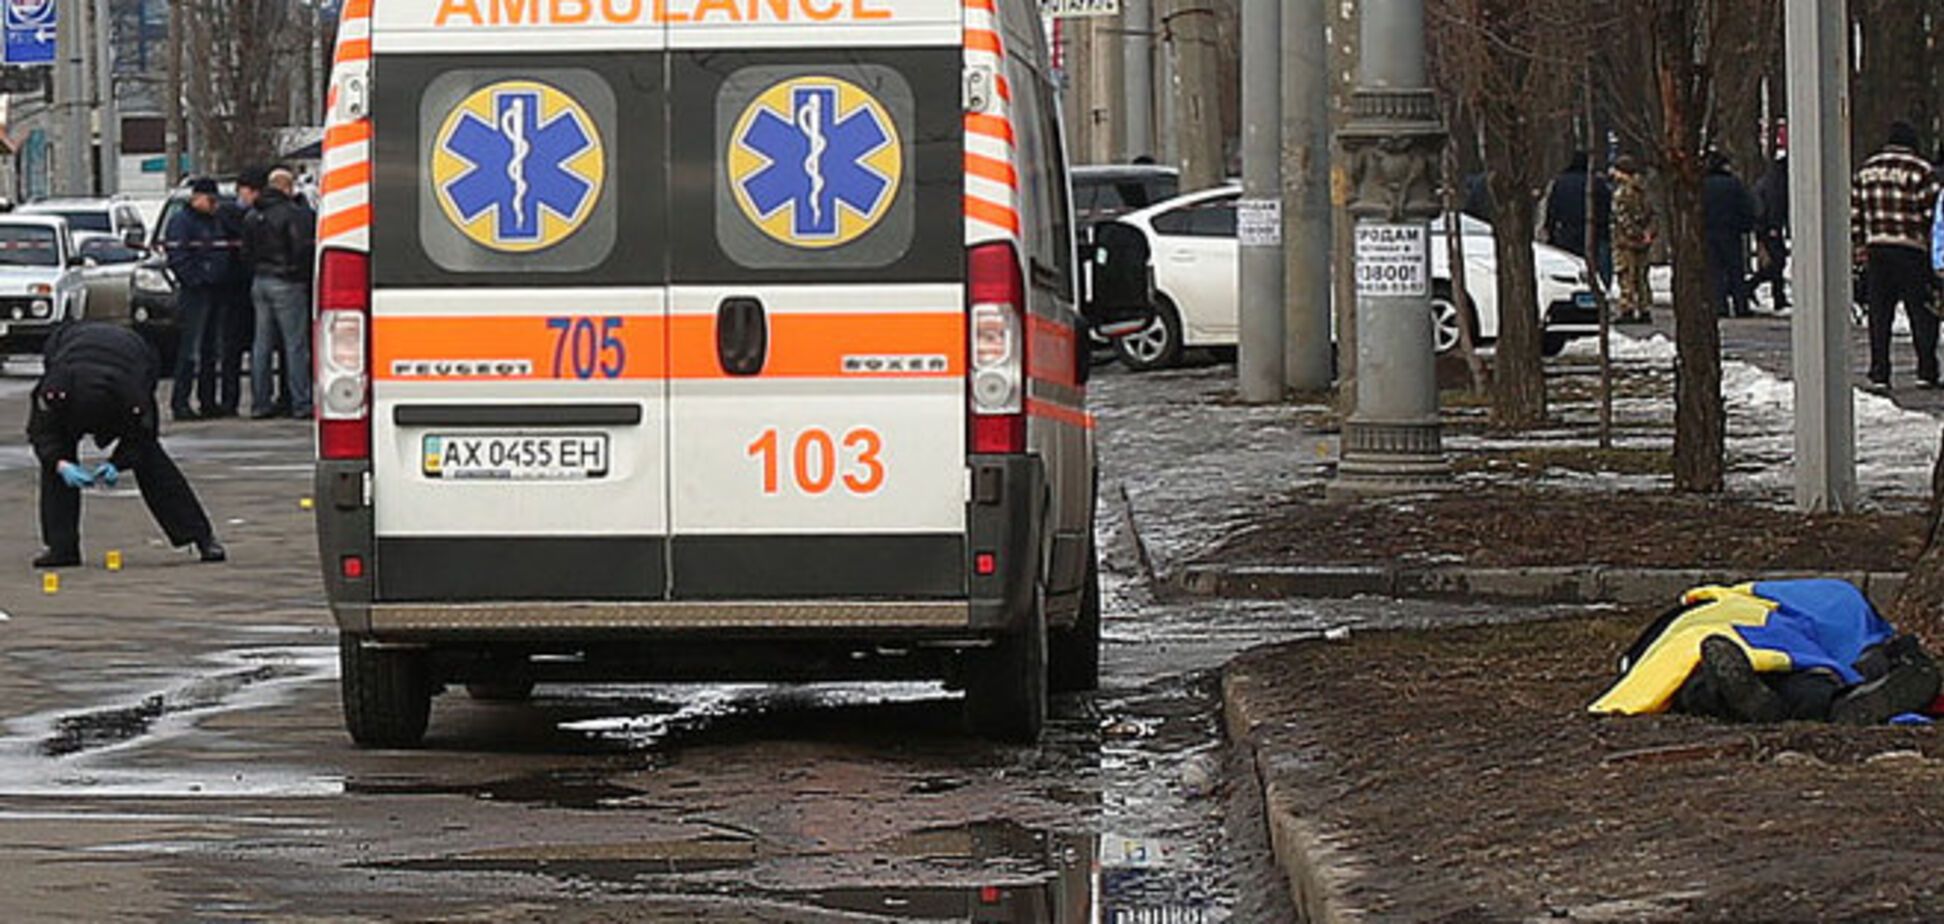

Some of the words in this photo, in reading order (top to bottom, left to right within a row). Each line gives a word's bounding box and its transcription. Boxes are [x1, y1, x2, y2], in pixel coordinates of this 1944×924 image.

[434, 0, 892, 25] AMBULANCE
[546, 316, 626, 378] 705
[444, 440, 482, 467] AX
[489, 440, 552, 467] 0455
[559, 440, 600, 467] EH
[748, 427, 885, 494] 103
